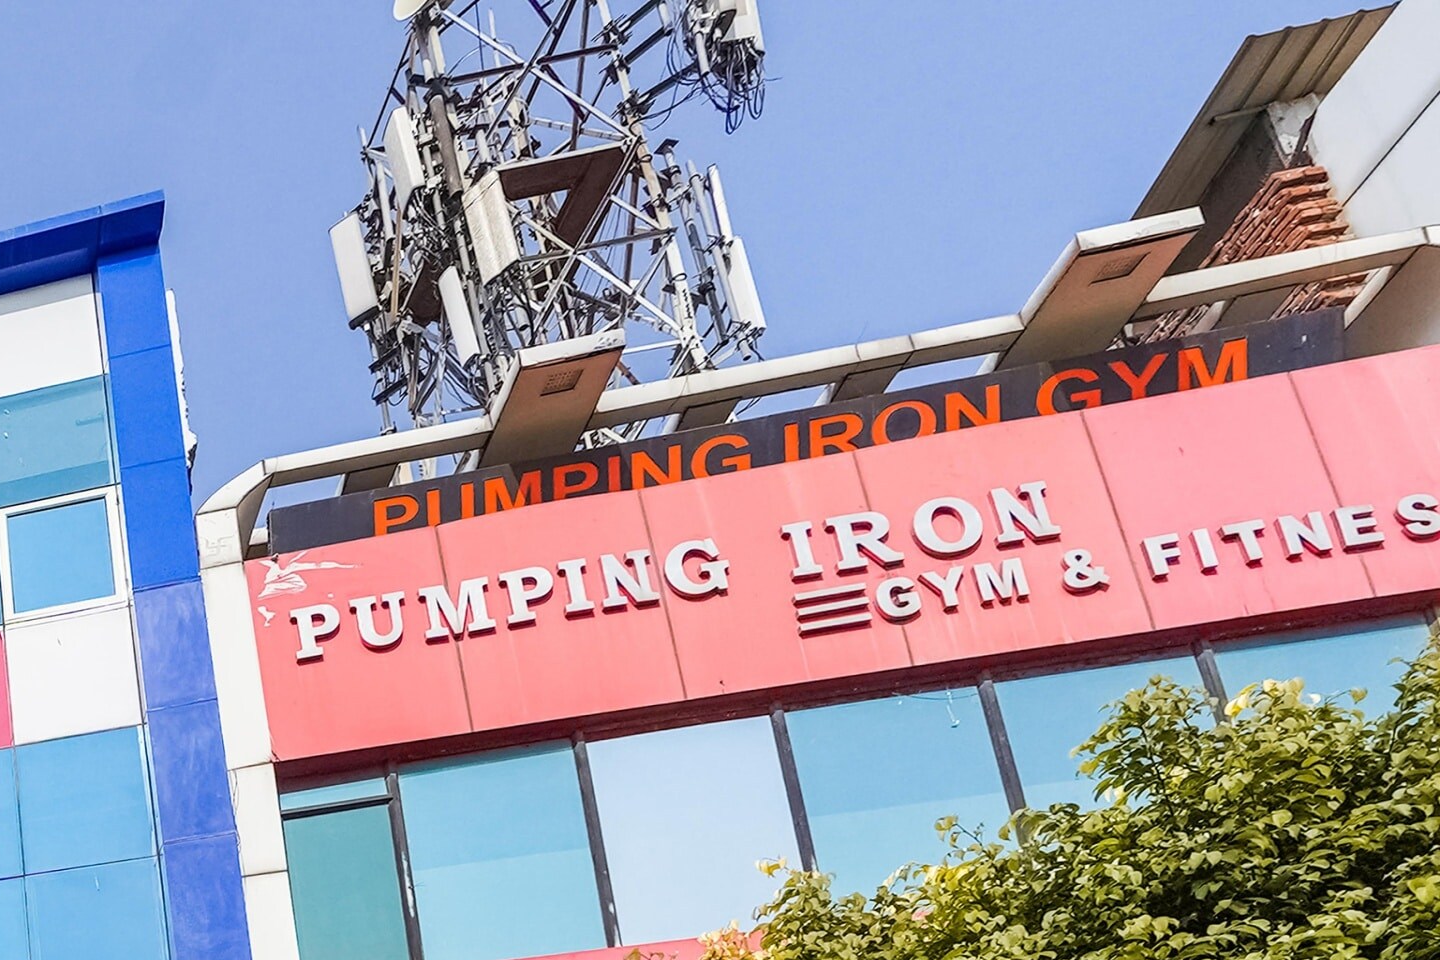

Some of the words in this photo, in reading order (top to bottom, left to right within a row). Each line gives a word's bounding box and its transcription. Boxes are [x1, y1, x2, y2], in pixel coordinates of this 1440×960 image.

[373, 434, 751, 535] PUMPING
[784, 384, 1001, 462] IRON
[1036, 338, 1248, 416] GYM
[289, 538, 731, 665] PUMPING
[780, 481, 1061, 581] IRON
[875, 557, 1031, 624] GYM
[1062, 549, 1110, 594] &
[1142, 494, 1440, 582] FITNES
